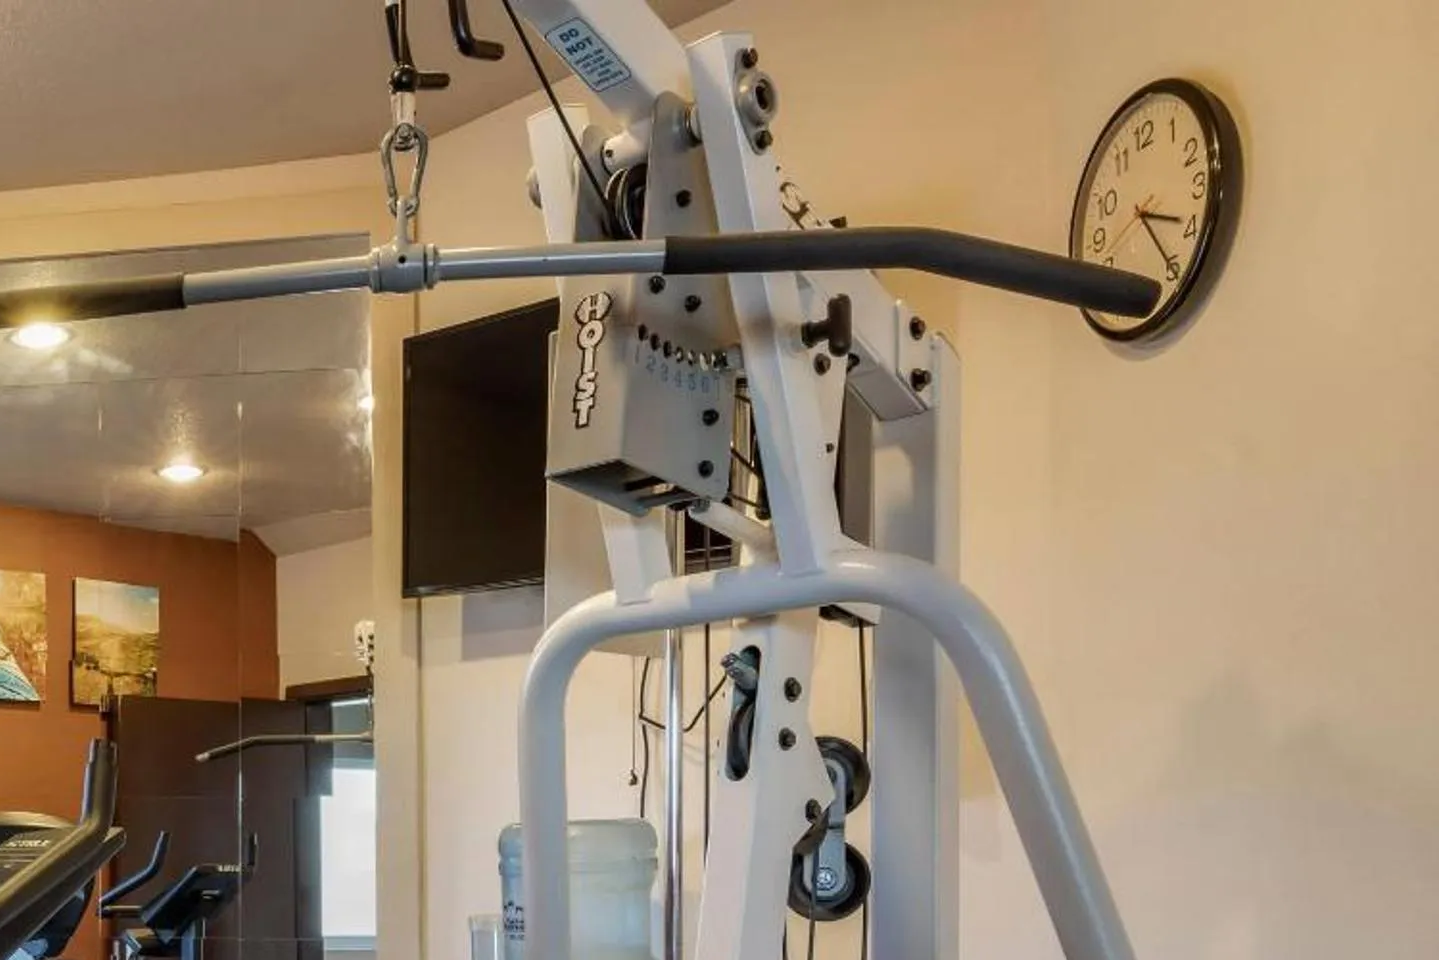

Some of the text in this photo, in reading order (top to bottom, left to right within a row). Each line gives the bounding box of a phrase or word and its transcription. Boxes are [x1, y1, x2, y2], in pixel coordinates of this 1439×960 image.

[559, 28, 580, 42] DO
[565, 37, 593, 56] NOT
[1133, 120, 1154, 152] 12
[1169, 117, 1176, 144] 1
[1113, 147, 1129, 176] 11
[1183, 137, 1198, 168] 2
[1191, 171, 1206, 200] 3
[1096, 189, 1117, 220] 10
[1092, 227, 1106, 253] 9
[1183, 214, 1197, 241] 4
[1166, 254, 1181, 282] 5
[573, 291, 612, 429] HOIST
